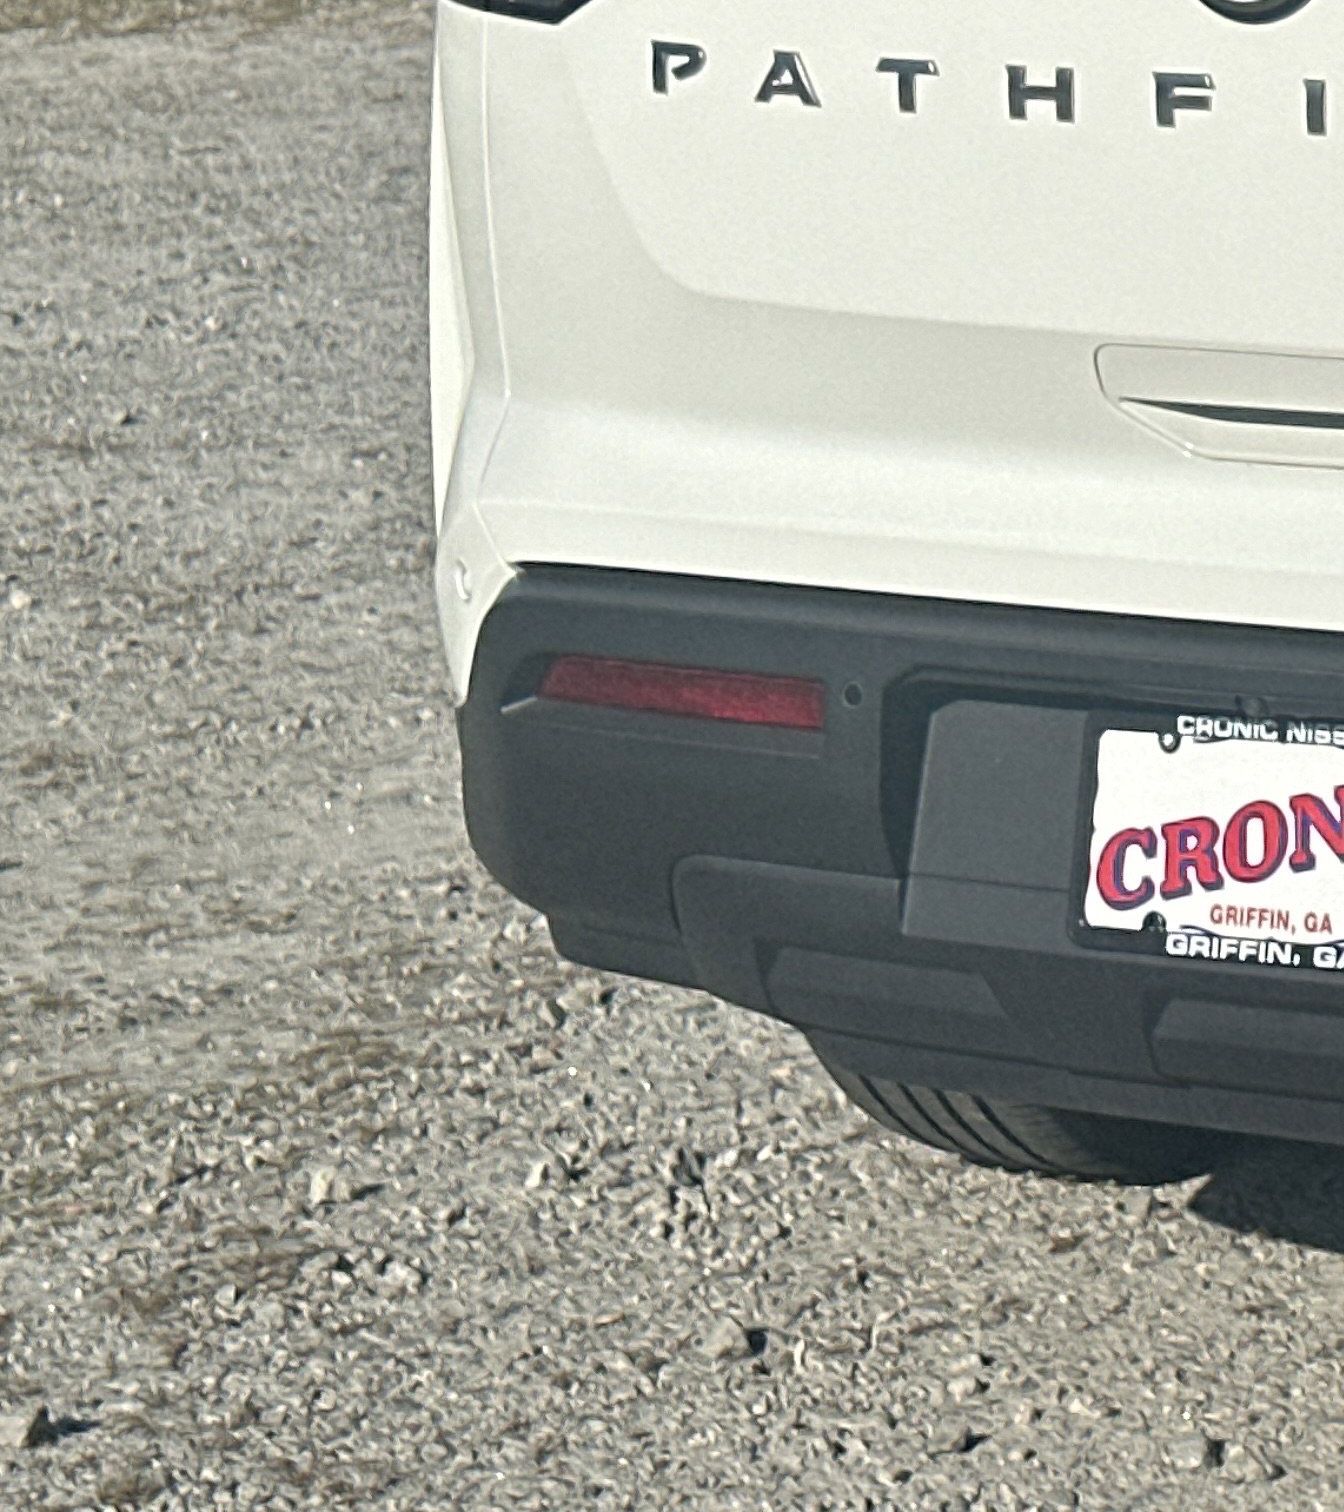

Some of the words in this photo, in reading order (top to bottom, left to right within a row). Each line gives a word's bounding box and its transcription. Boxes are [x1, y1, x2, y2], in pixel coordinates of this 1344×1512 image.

[1176, 714, 1279, 742] CRONIC
[1210, 903, 1296, 936] GRIFFIN,
[1304, 911, 1334, 936] GA
